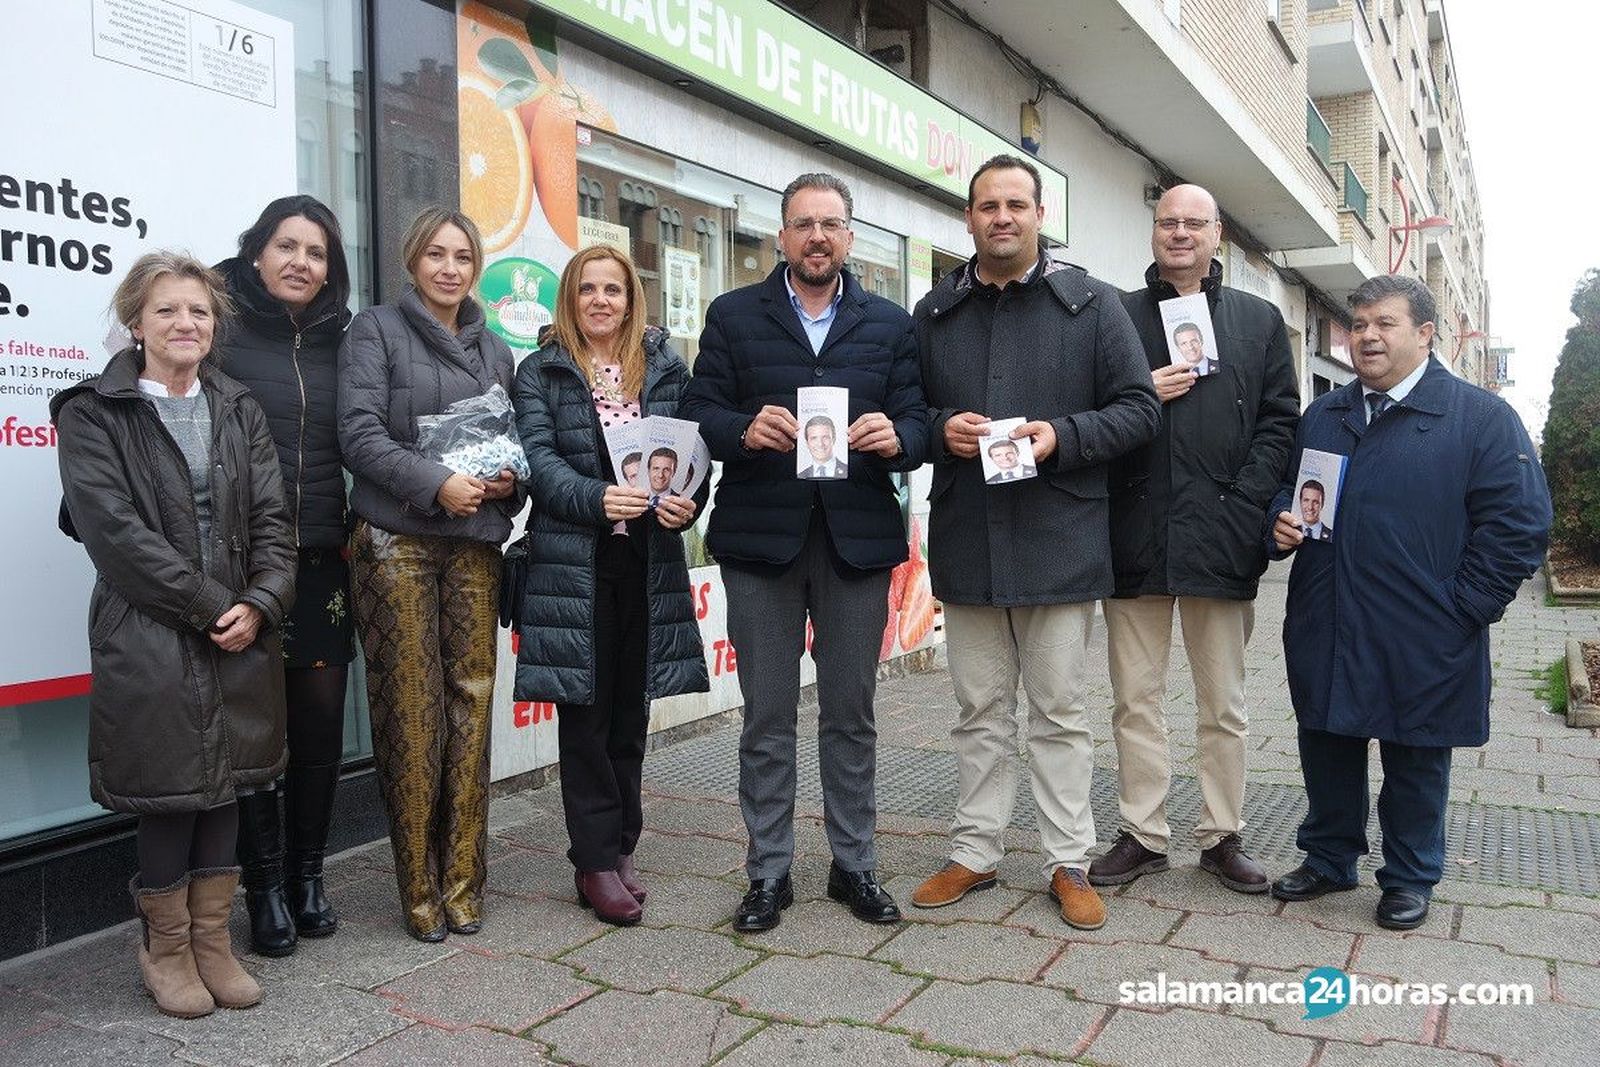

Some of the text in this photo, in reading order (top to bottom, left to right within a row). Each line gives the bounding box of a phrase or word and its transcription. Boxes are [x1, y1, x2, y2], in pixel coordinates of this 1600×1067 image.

[756, 27, 802, 107] DE
[811, 58, 919, 162] FRUTAS
[927, 119, 974, 183] DON
[0, 174, 148, 240] entes,
[0, 228, 113, 276] rnos
[8, 339, 46, 358] falte
[48, 344, 90, 361] nada.
